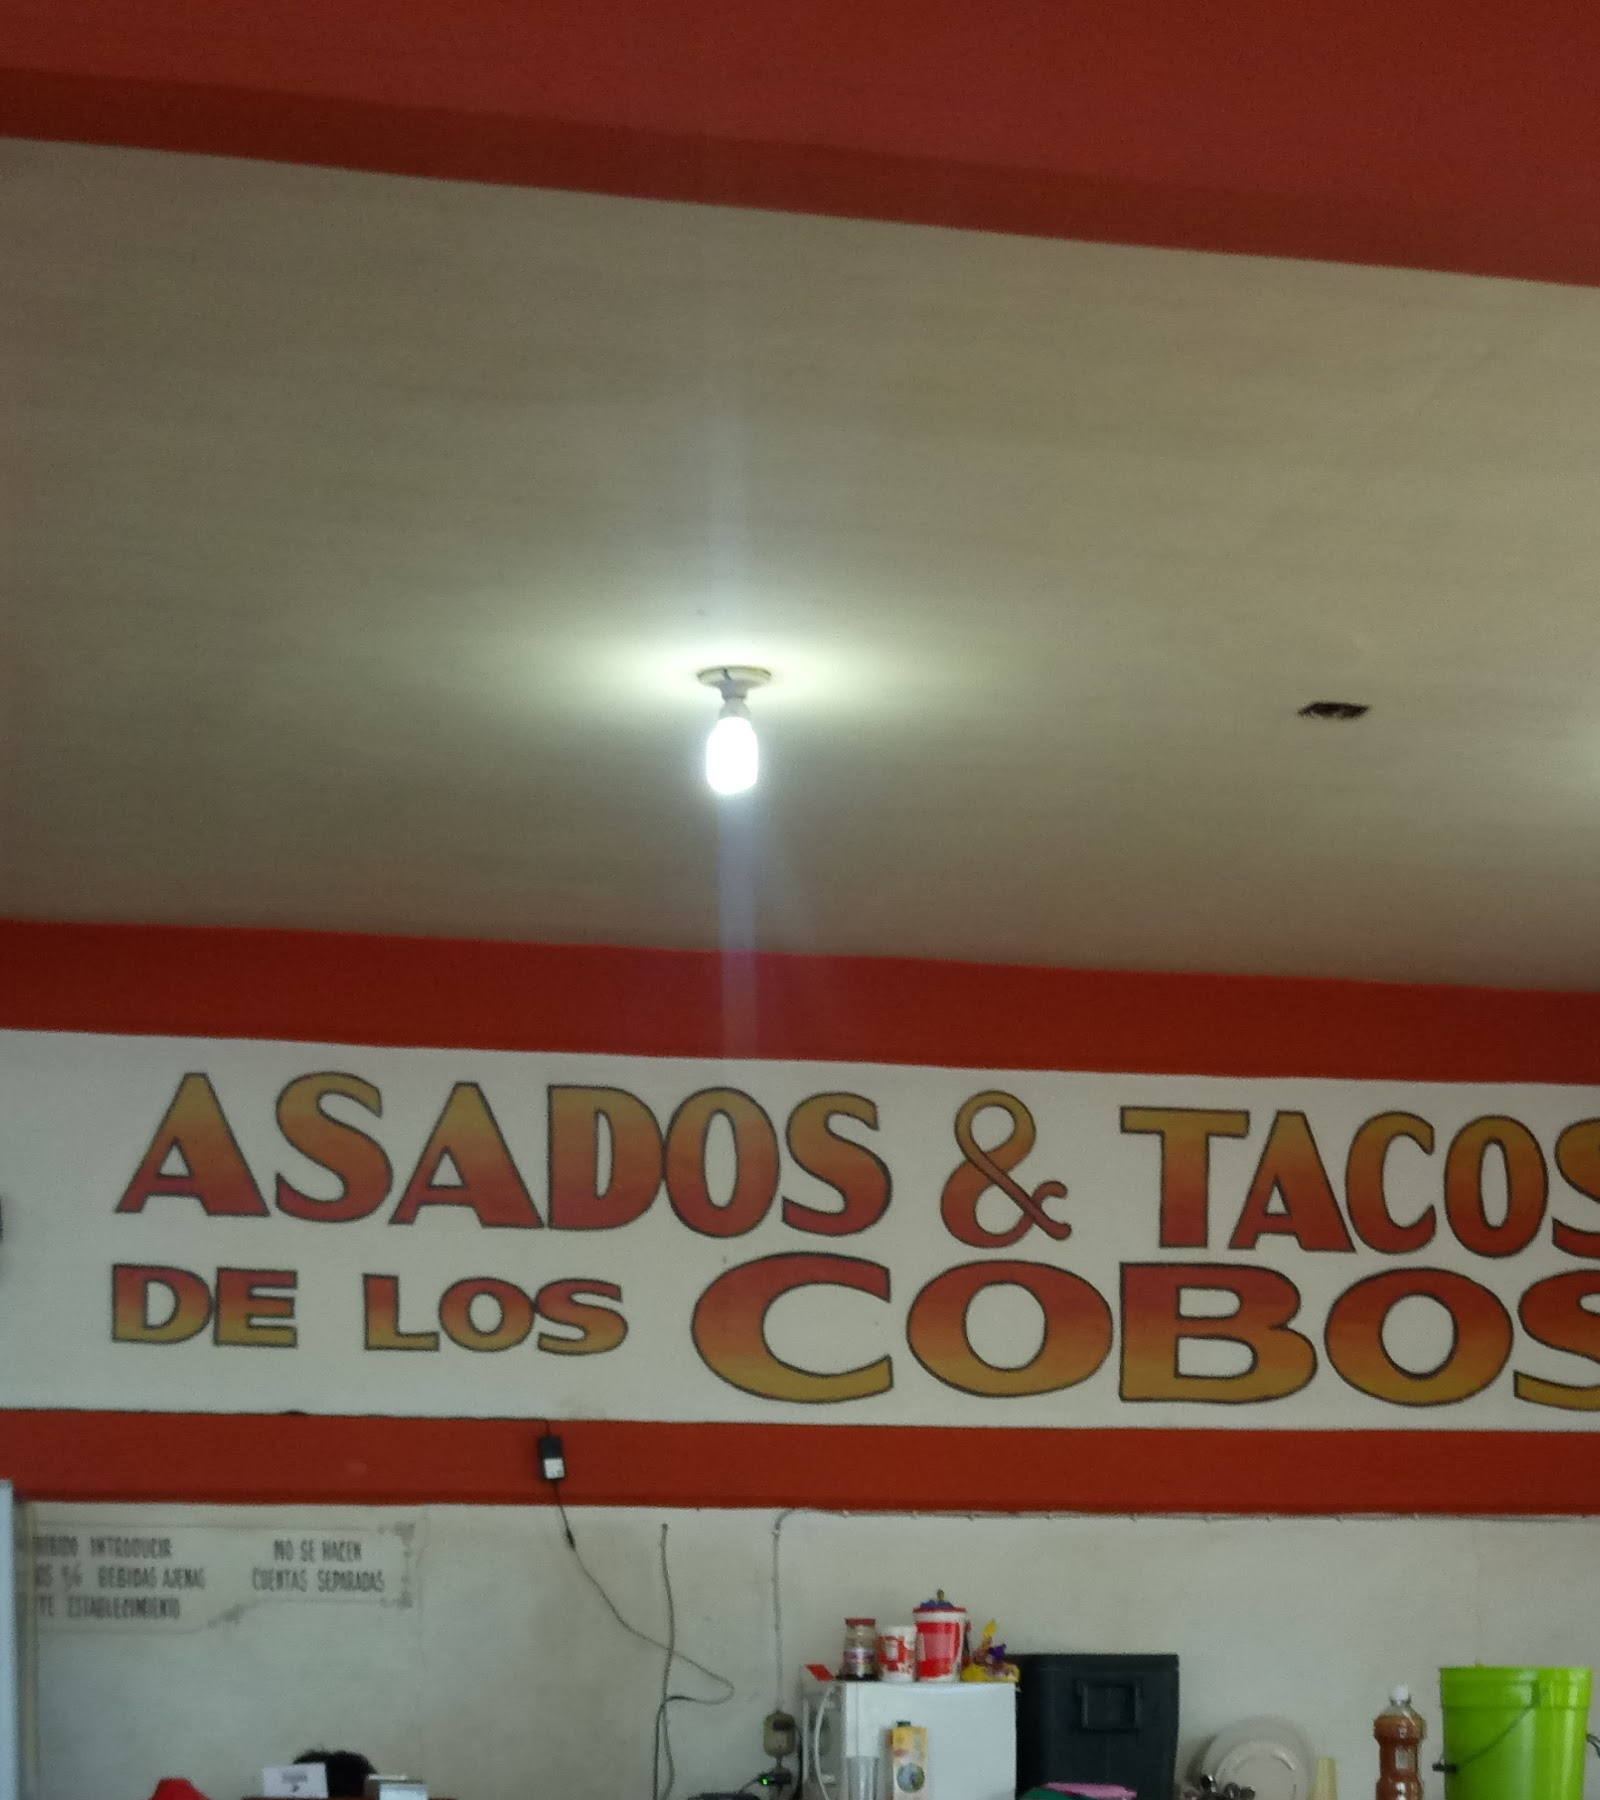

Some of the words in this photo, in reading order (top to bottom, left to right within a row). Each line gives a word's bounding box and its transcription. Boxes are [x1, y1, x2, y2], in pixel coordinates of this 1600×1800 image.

[114, 1072, 892, 1238] ASADOS
[939, 1090, 1073, 1249] &
[110, 1263, 299, 1350] DE
[274, 1539, 294, 1561] NO
[300, 1539, 315, 1562] SE
[322, 1540, 363, 1563] HACEN
[97, 1566, 157, 1588] BEBIDAS
[252, 1567, 308, 1592] CUENTAS
[317, 1569, 385, 1593] SEPARADAS
